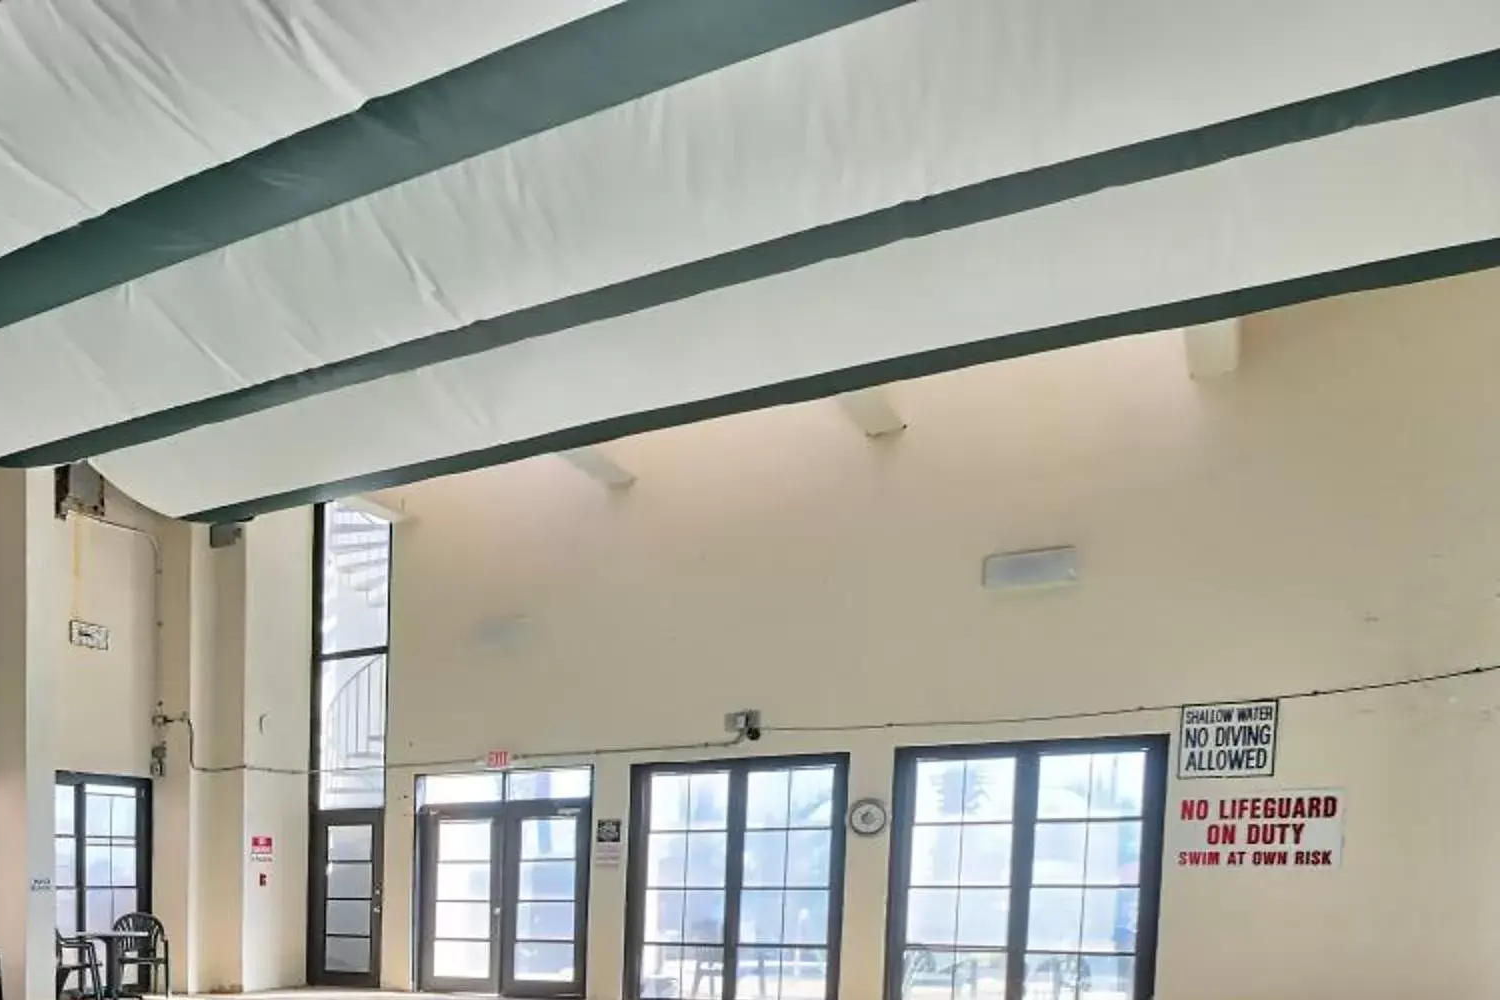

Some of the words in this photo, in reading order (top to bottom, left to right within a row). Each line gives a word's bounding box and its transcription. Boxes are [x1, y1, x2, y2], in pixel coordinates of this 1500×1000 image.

[1185, 707, 1235, 725] SHALLOW
[1237, 705, 1273, 722] WATER
[1185, 727, 1209, 748] NO
[1215, 724, 1272, 747] DIVING
[1185, 748, 1268, 771] ALLOWED
[1180, 799, 1209, 820] NO
[1218, 795, 1338, 819] LIFEGUARD
[1206, 825, 1236, 845] ON
[1246, 823, 1306, 844] DUTY
[1178, 851, 1221, 866] SWIM
[1227, 851, 1247, 865] AT
[1251, 851, 1288, 865] OWN
[1293, 850, 1333, 865] RISK
